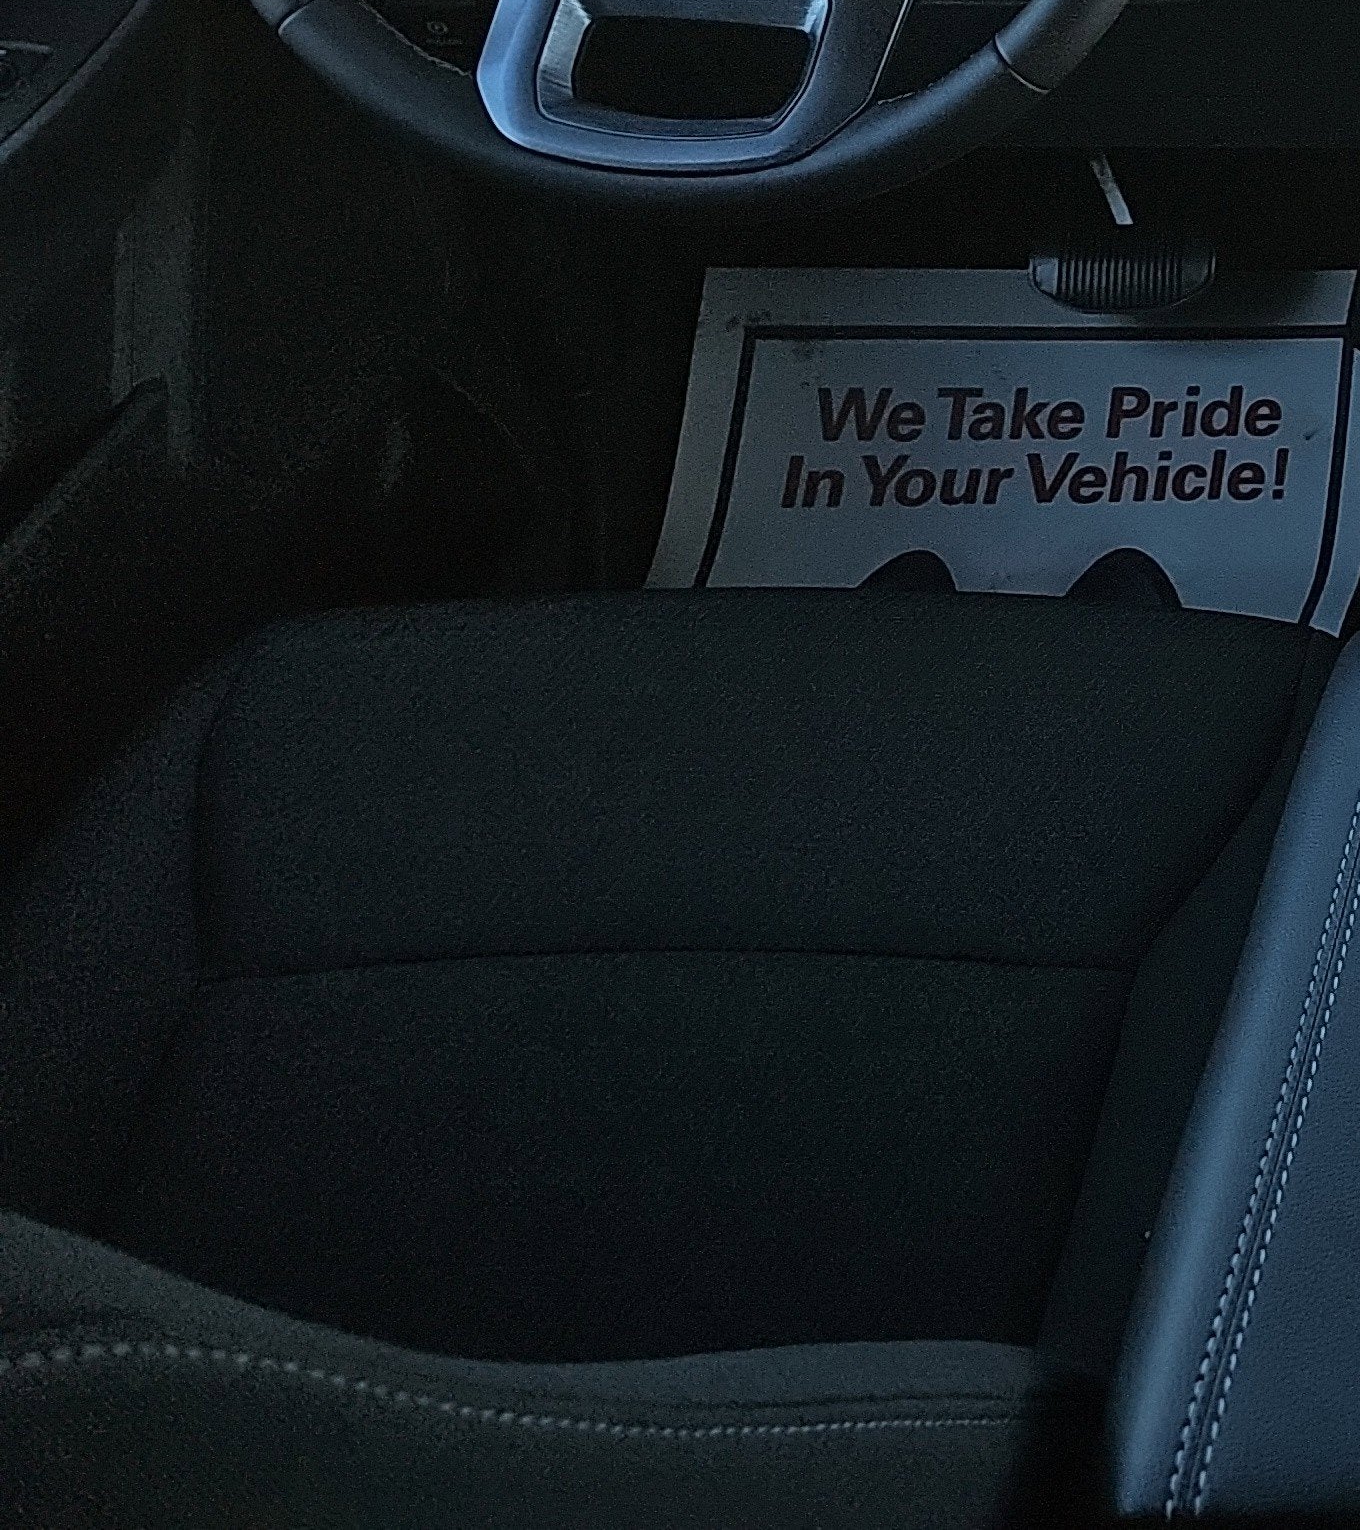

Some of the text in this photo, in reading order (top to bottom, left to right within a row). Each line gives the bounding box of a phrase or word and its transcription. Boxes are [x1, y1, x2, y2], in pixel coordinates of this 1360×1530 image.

[817, 384, 1283, 443] We Take Pride
[780, 447, 1289, 509] In Your Vehicle!
